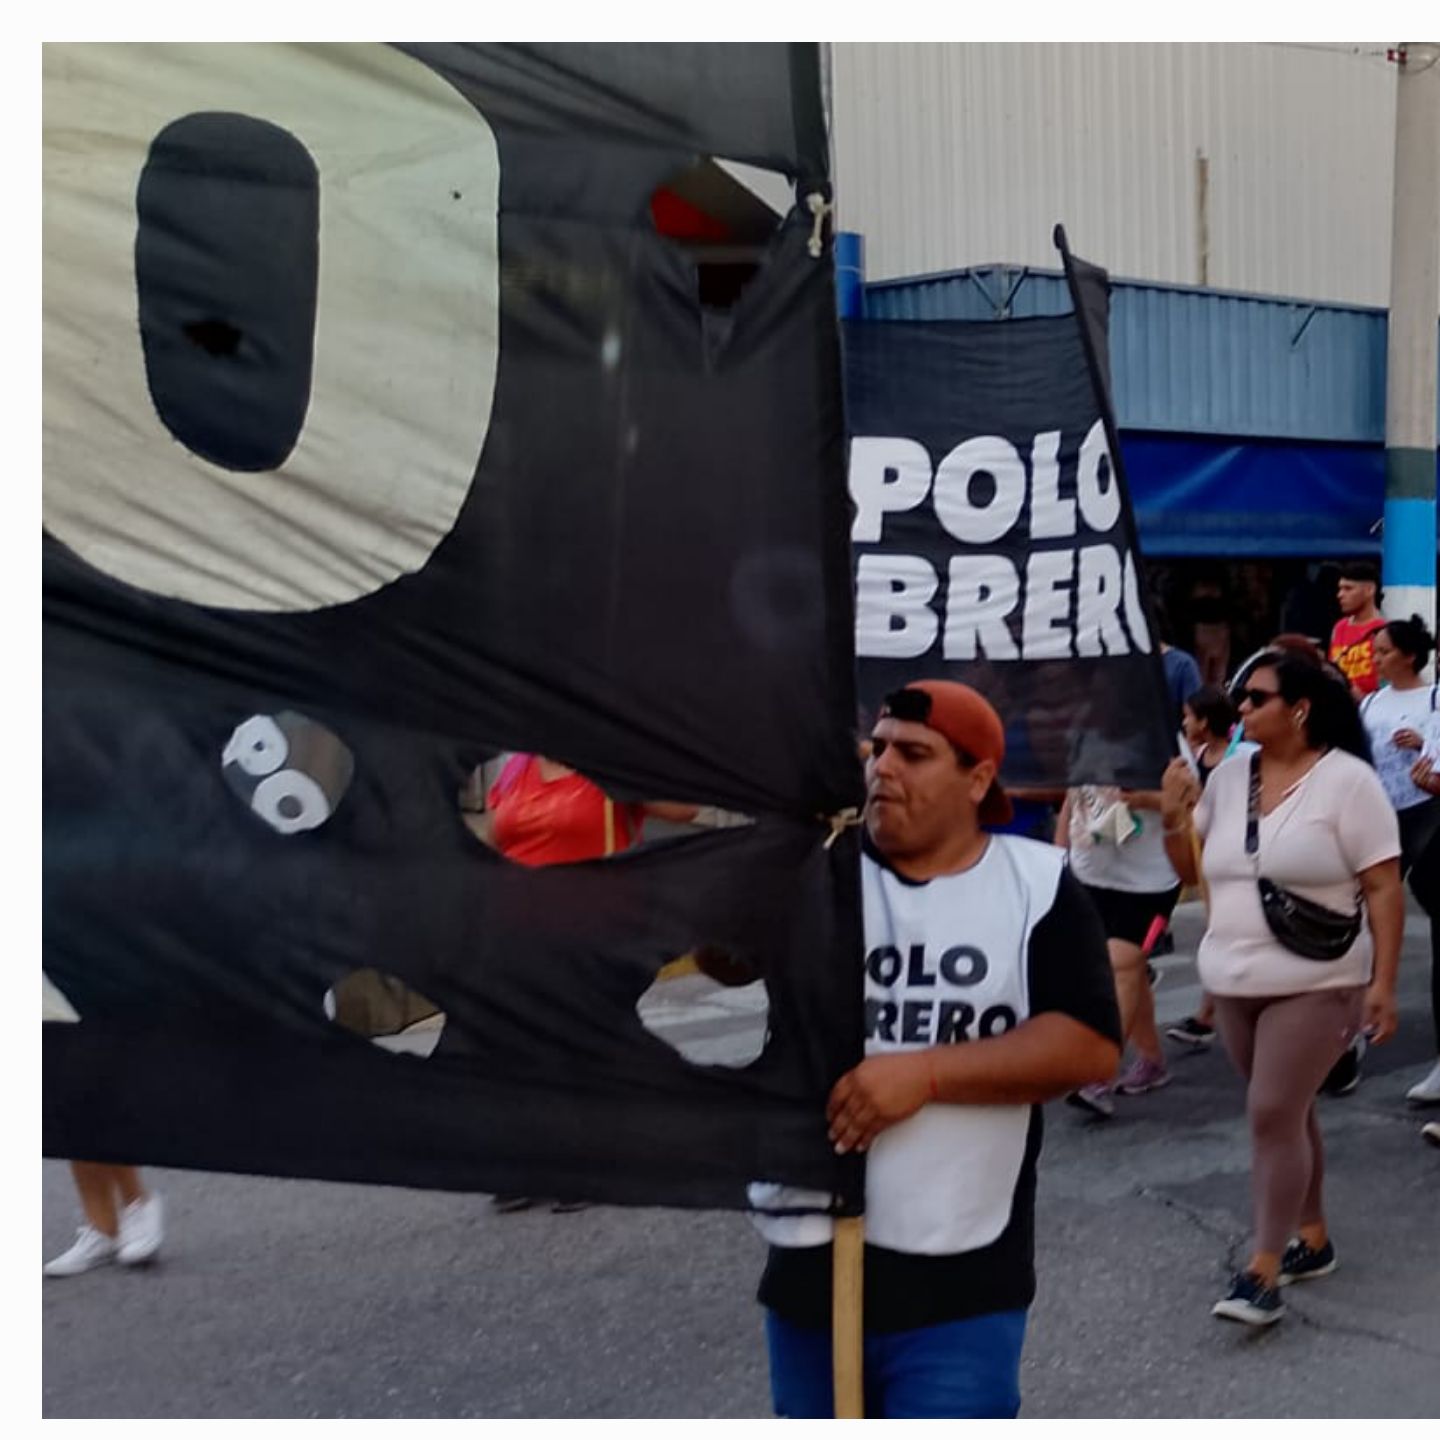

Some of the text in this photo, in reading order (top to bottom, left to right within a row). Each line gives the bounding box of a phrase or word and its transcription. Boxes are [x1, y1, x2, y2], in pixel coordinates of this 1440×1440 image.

[848, 418, 1122, 544] POLO
[866, 943, 989, 988] OLO
[865, 996, 1018, 1044] RERO
